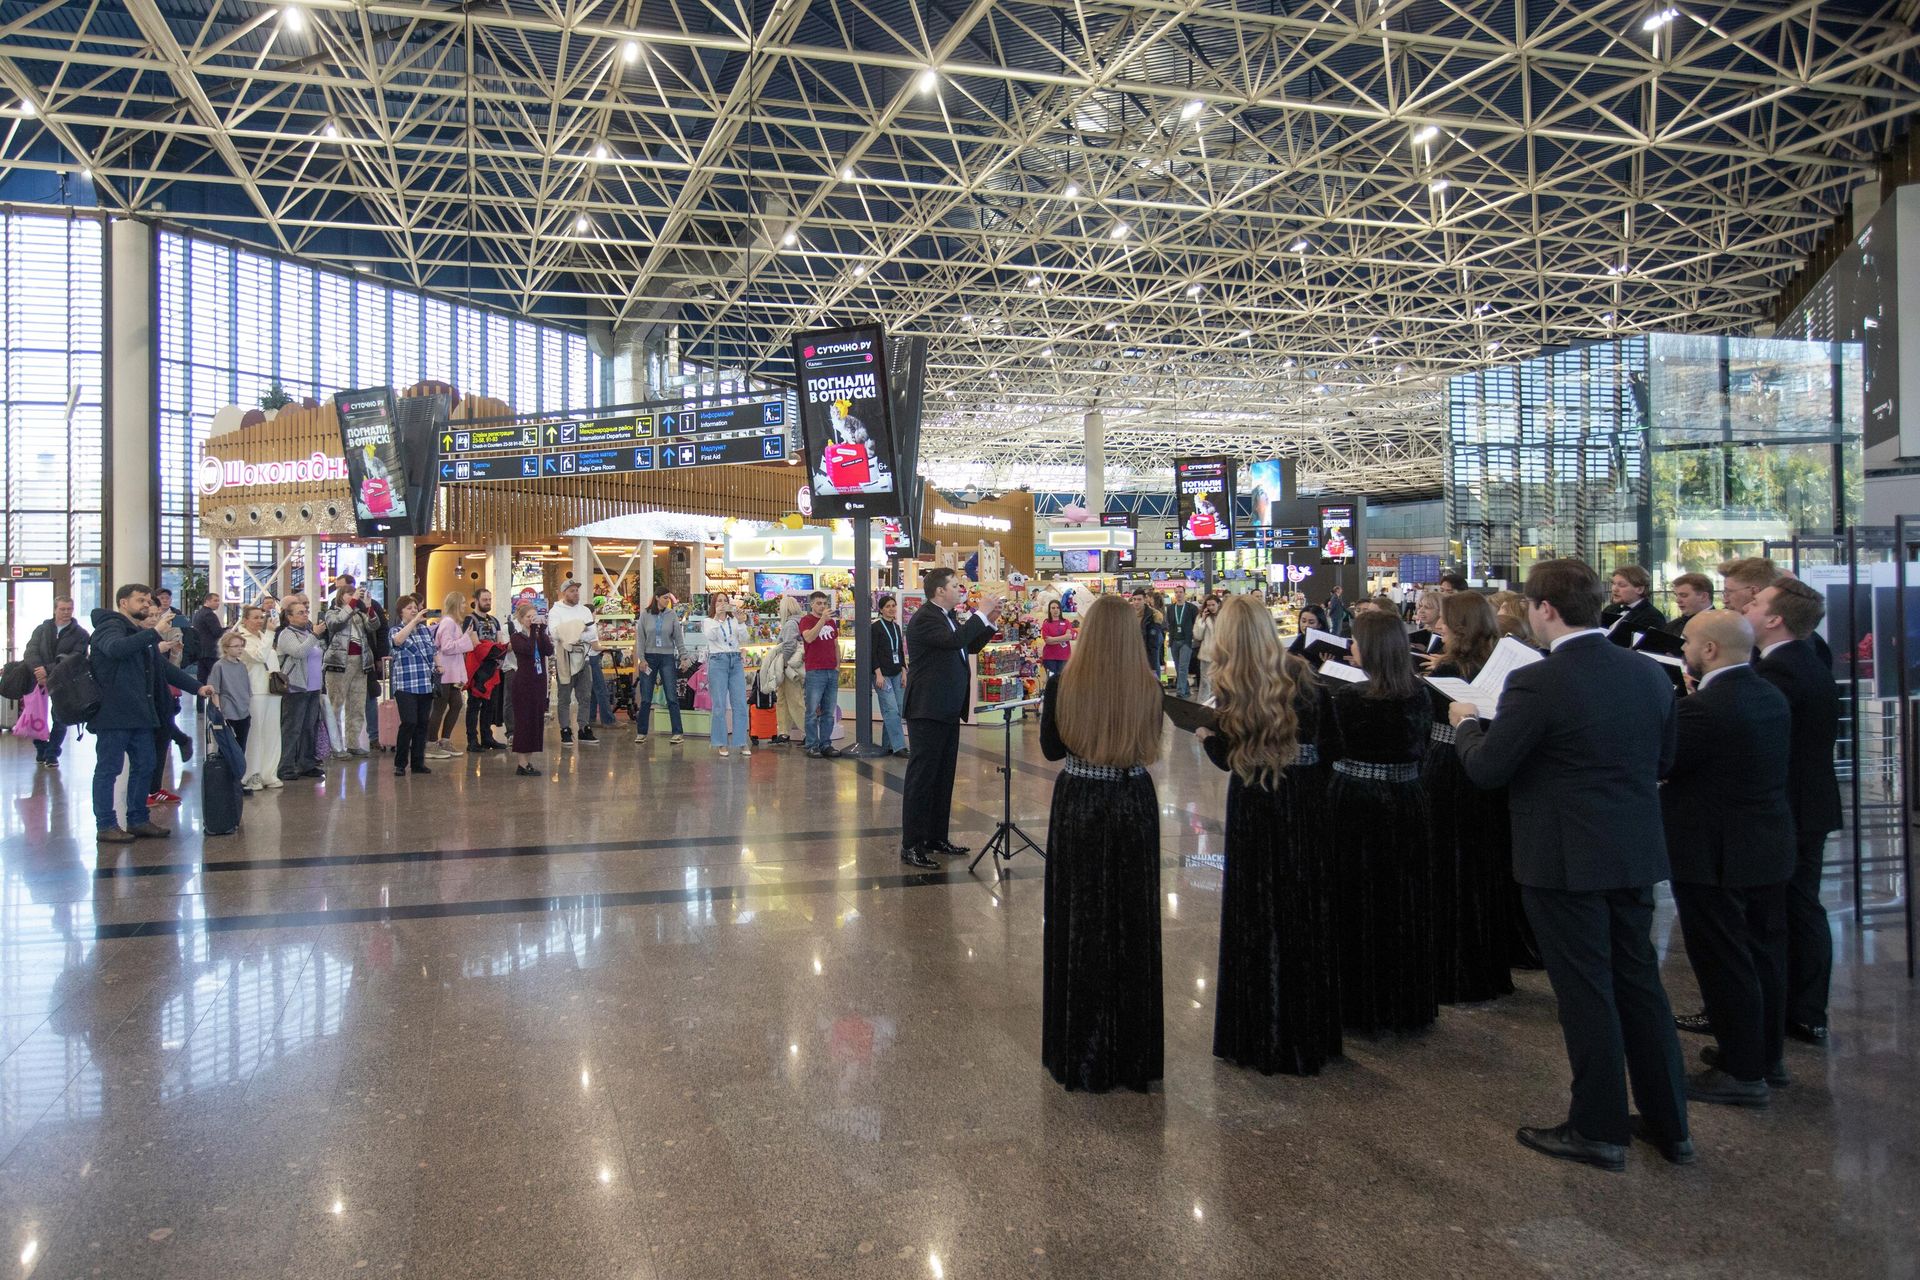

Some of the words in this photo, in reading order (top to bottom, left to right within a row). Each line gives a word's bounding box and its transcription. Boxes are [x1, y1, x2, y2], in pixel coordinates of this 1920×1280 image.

[817, 341, 872, 354] СУТОЧНО.РУ
[808, 373, 875, 391] ПОГНАЛИ
[810, 392, 818, 403] В
[819, 386, 876, 402] ОТПУСК!
[700, 410, 734, 418] Информация
[347, 424, 389, 439] ПОГНАЛИ
[580, 426, 618, 434] Международные
[349, 440, 355, 448] В
[356, 434, 390, 446] ОТПУСК!
[878, 462, 887, 470] 6+
[1182, 480, 1222, 488] ПОГНАЛИ
